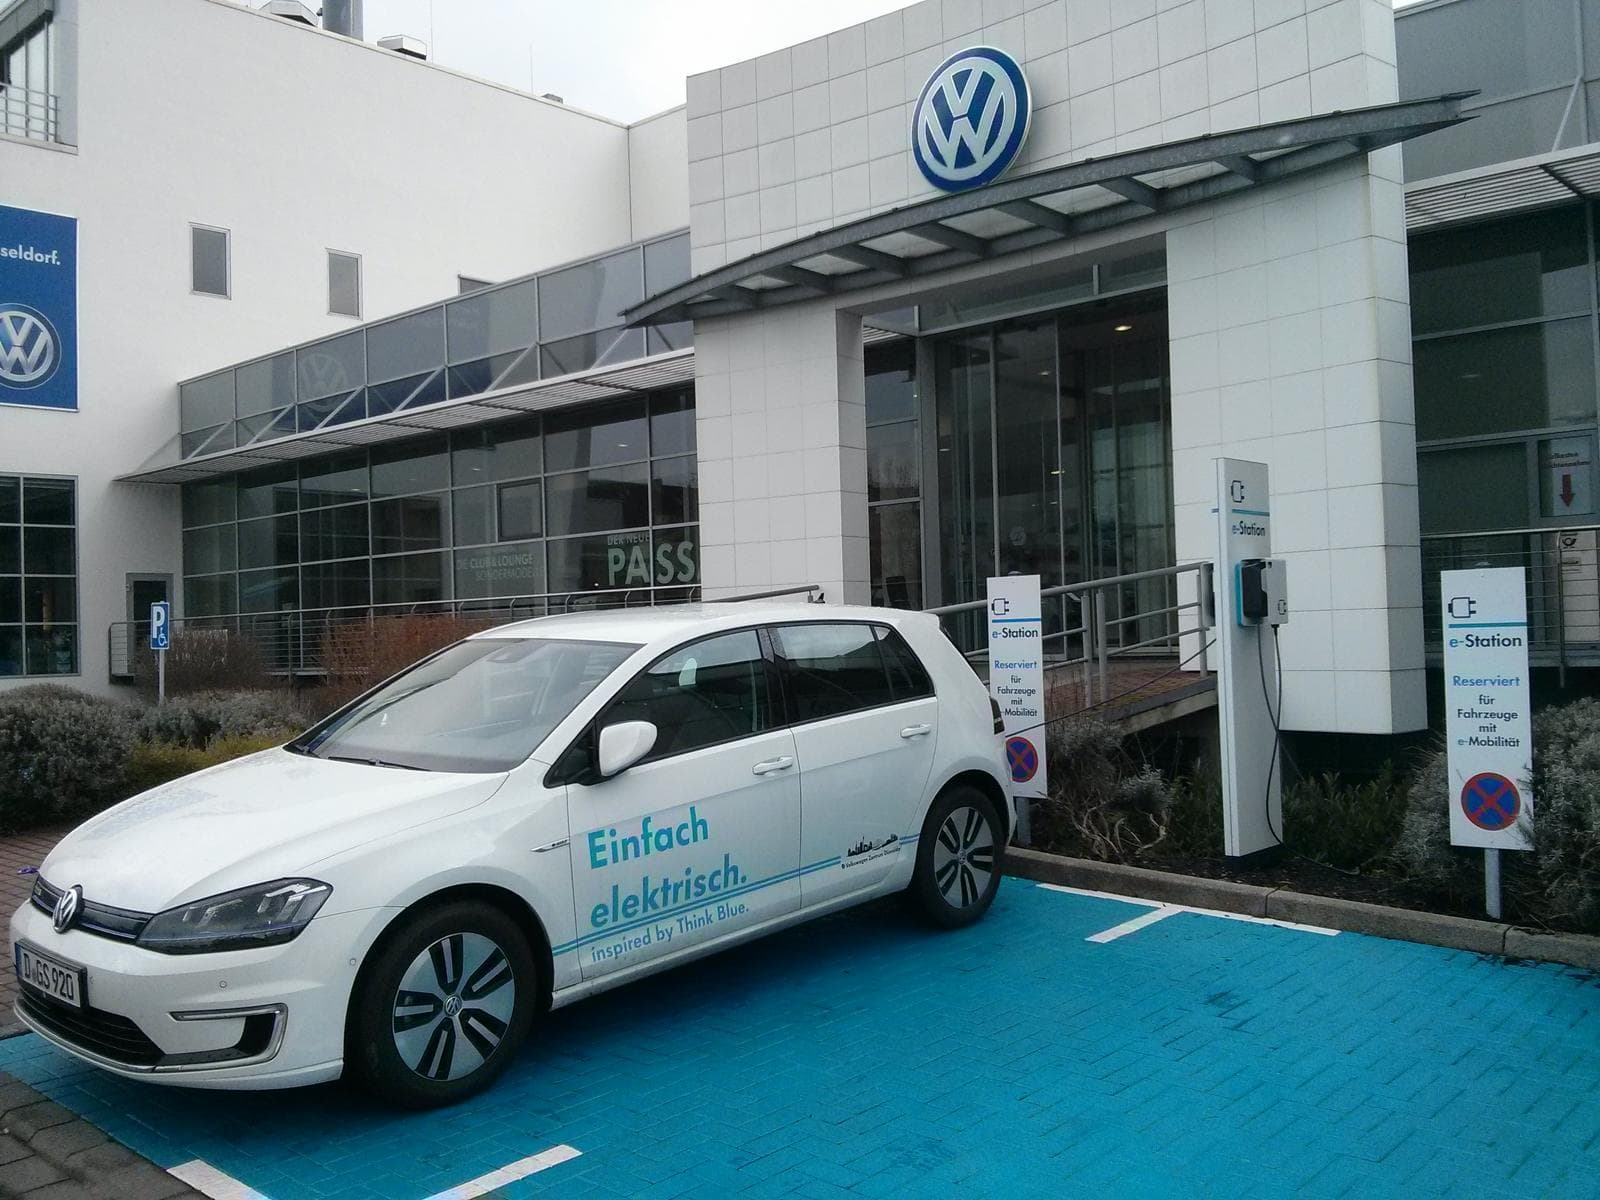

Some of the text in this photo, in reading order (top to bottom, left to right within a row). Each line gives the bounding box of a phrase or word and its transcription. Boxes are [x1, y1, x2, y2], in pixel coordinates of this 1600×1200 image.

[0, 244, 61, 265] seldorf.
[1232, 520, 1266, 537] e-Station
[608, 541, 695, 586] PASS
[153, 606, 165, 638] P
[992, 627, 1038, 639] e-Station
[1449, 633, 1522, 648] e-Station
[994, 660, 1037, 669] Reserviert
[1010, 675, 1022, 684] für
[1453, 675, 1520, 686] Reserviert
[997, 685, 1036, 696] Fahrzeuge
[1010, 697, 1023, 705] mit
[1479, 694, 1495, 705] für
[1001, 708, 1038, 717] -Mobilität
[1457, 708, 1518, 722] Fahrzeuge
[1479, 723, 1497, 733] mit
[1457, 736, 1520, 747] e-Mobilität
[588, 806, 709, 870] Einfach
[590, 853, 747, 928] elektrisch.
[592, 903, 749, 962] inspired by Think Blue.
[23, 953, 74, 1000] D GS 920
